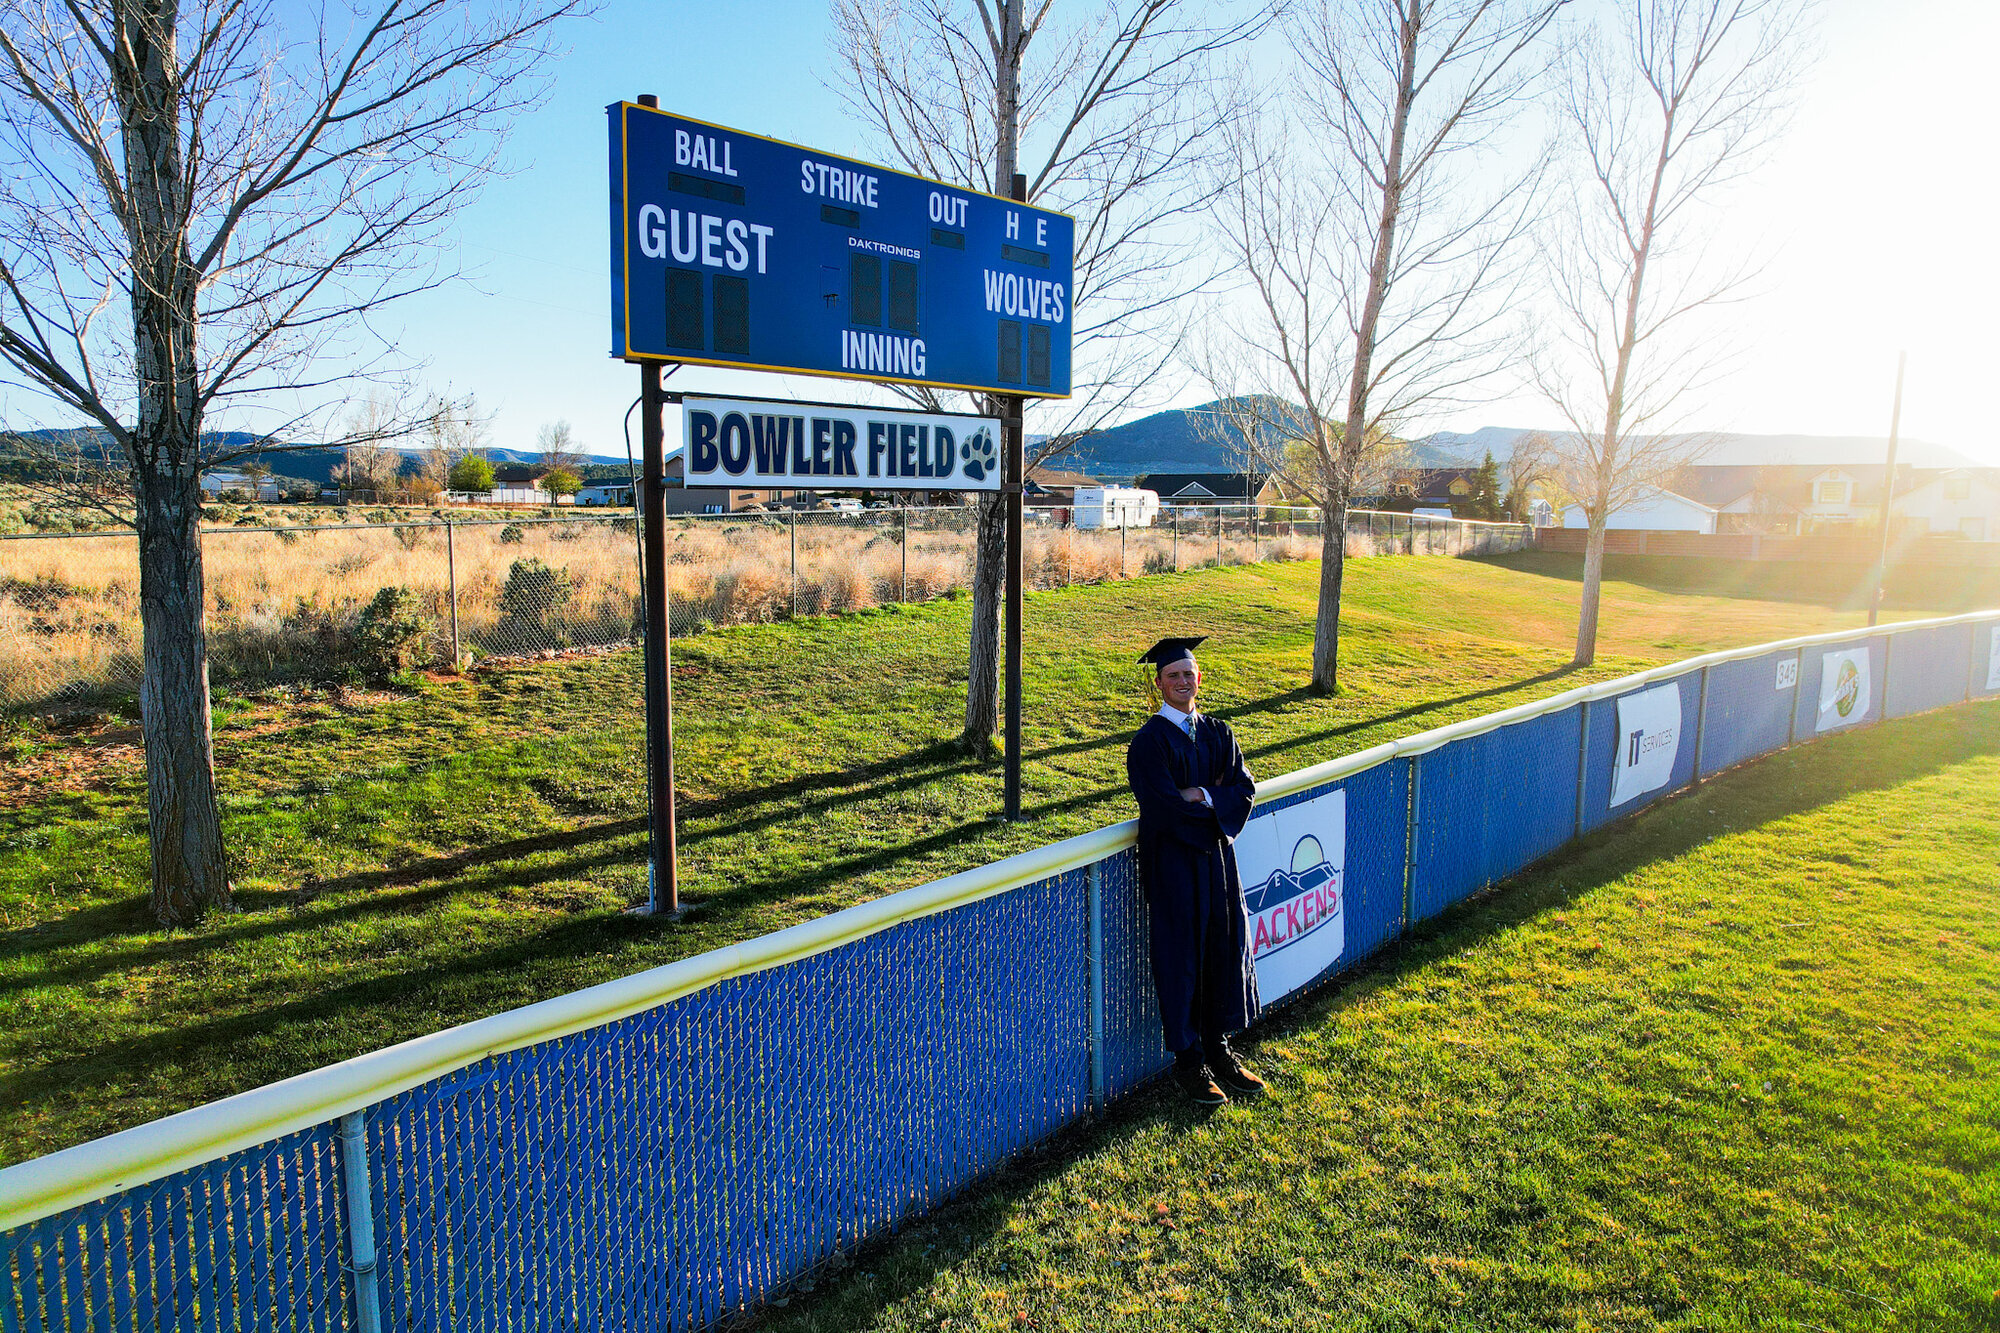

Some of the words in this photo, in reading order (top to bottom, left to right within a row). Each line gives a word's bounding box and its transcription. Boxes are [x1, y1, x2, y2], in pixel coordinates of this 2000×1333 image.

[675, 129, 738, 178] BALL
[801, 160, 879, 209] STRIKE
[929, 191, 969, 228] OUT
[1006, 210, 1019, 240] H
[1037, 218, 1047, 247] E
[638, 203, 774, 275] GUEST
[848, 236, 921, 259] DAKTRONICS
[984, 268, 1065, 324] WOLVES
[842, 330, 926, 377] INNING
[688, 409, 860, 478] BOWLER
[867, 420, 958, 480] FIELD
[1777, 663, 1796, 685] 345
[1628, 729, 1644, 768] IT
[1642, 728, 1673, 754] SERVICES
[1252, 878, 1337, 956] ACKENS
